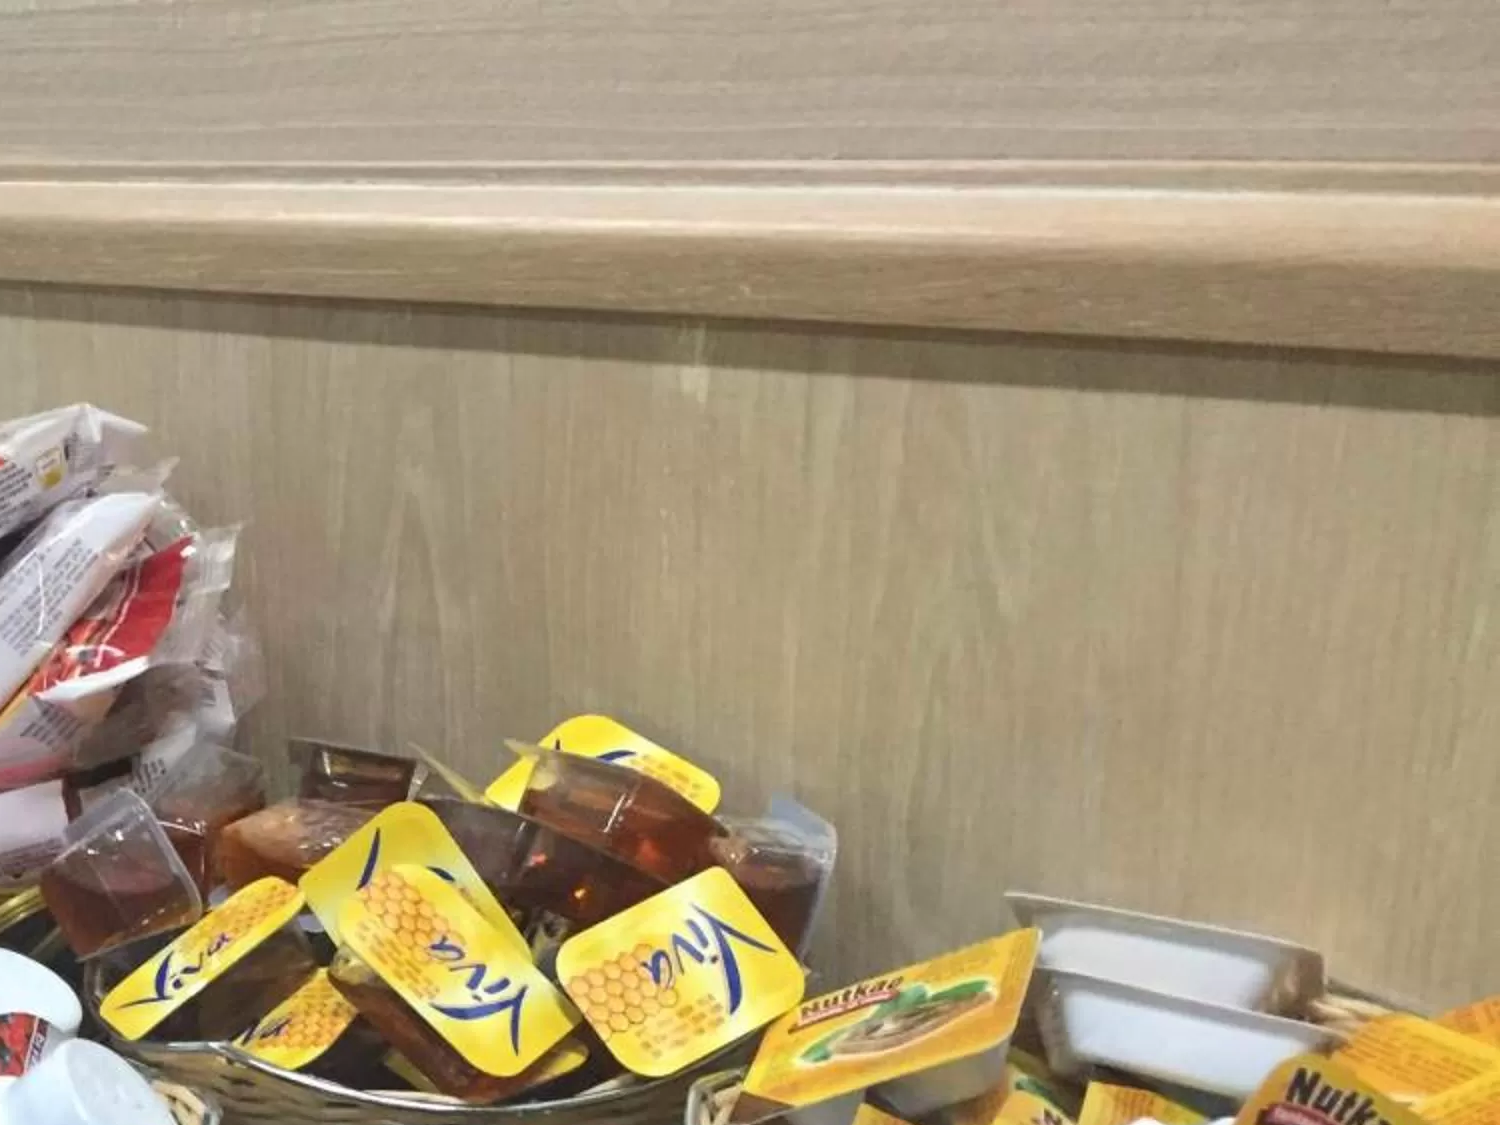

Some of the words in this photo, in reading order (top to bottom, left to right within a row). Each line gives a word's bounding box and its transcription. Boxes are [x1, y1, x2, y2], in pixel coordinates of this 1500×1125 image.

[114, 933, 230, 1009] Viva
[428, 935, 528, 1056] Viva
[641, 902, 778, 1016] Viva
[800, 976, 905, 1018] Nutkao
